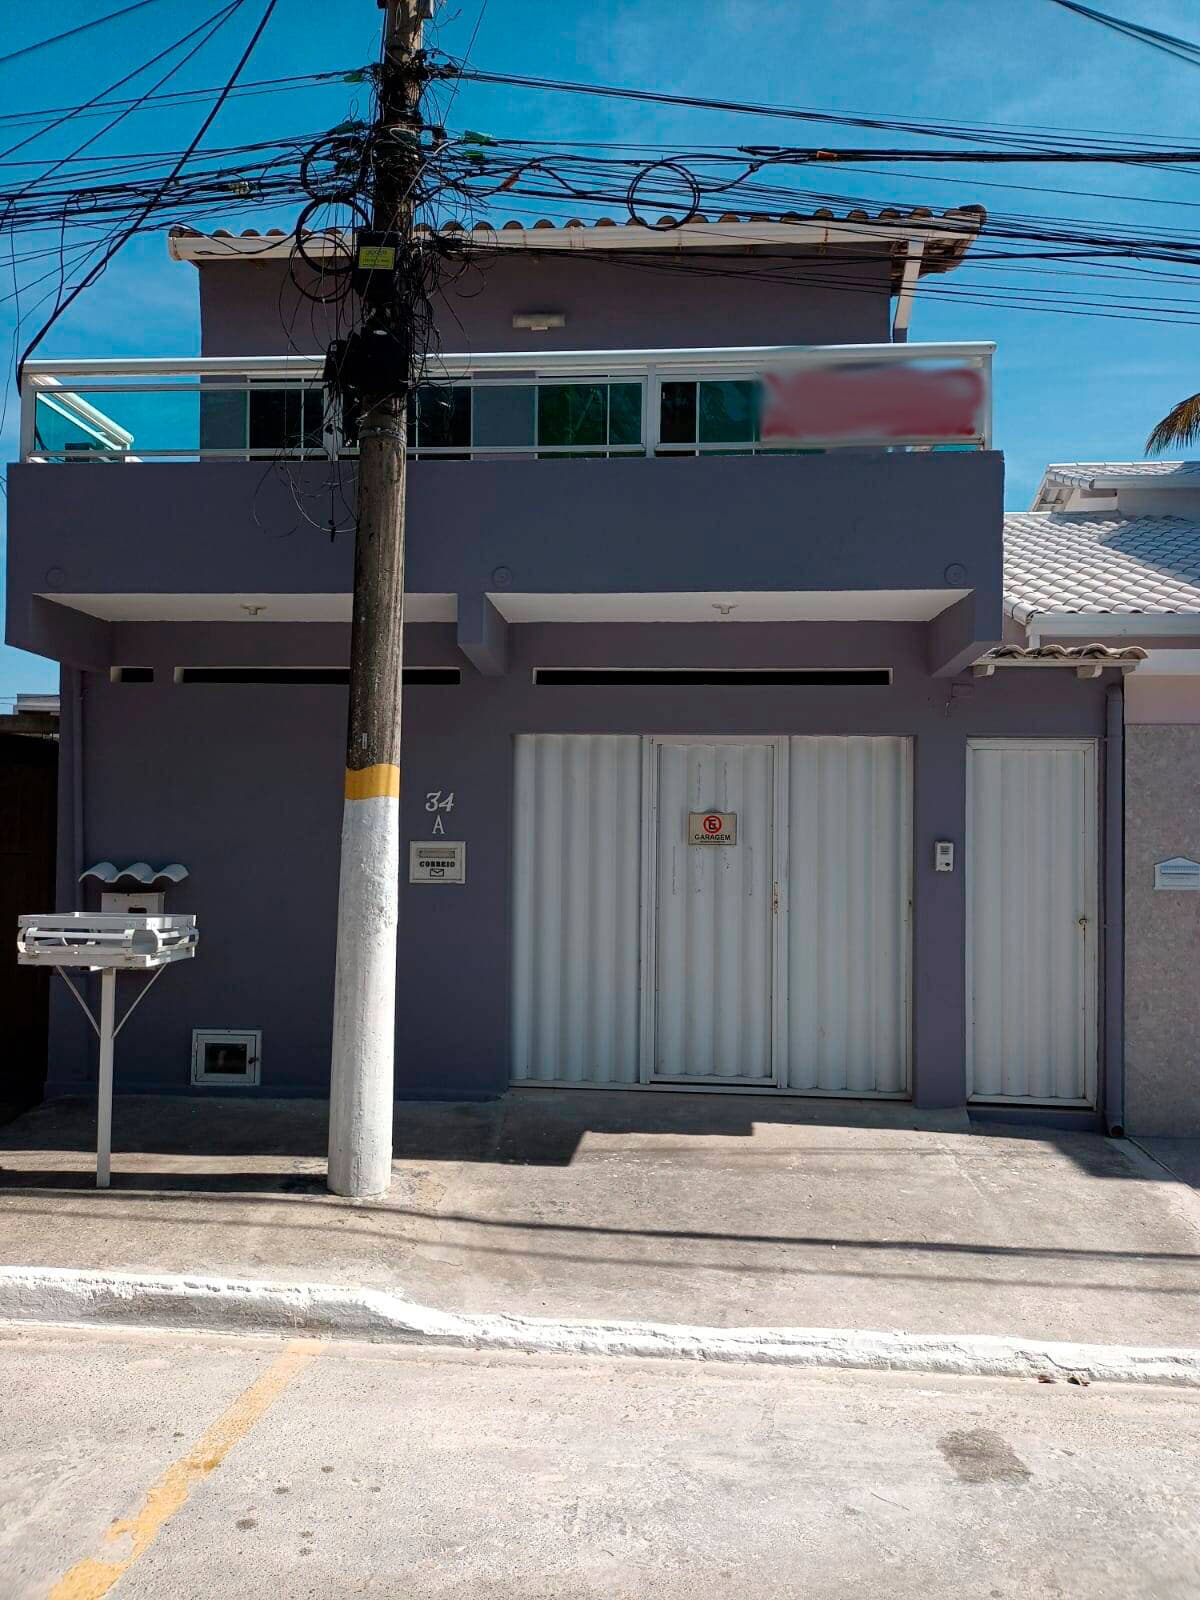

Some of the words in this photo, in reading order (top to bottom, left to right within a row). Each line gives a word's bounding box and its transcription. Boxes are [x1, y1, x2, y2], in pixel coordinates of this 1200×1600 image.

[425, 791, 454, 812] 34
[431, 814, 445, 834] A
[694, 833, 731, 841] GARAGEM
